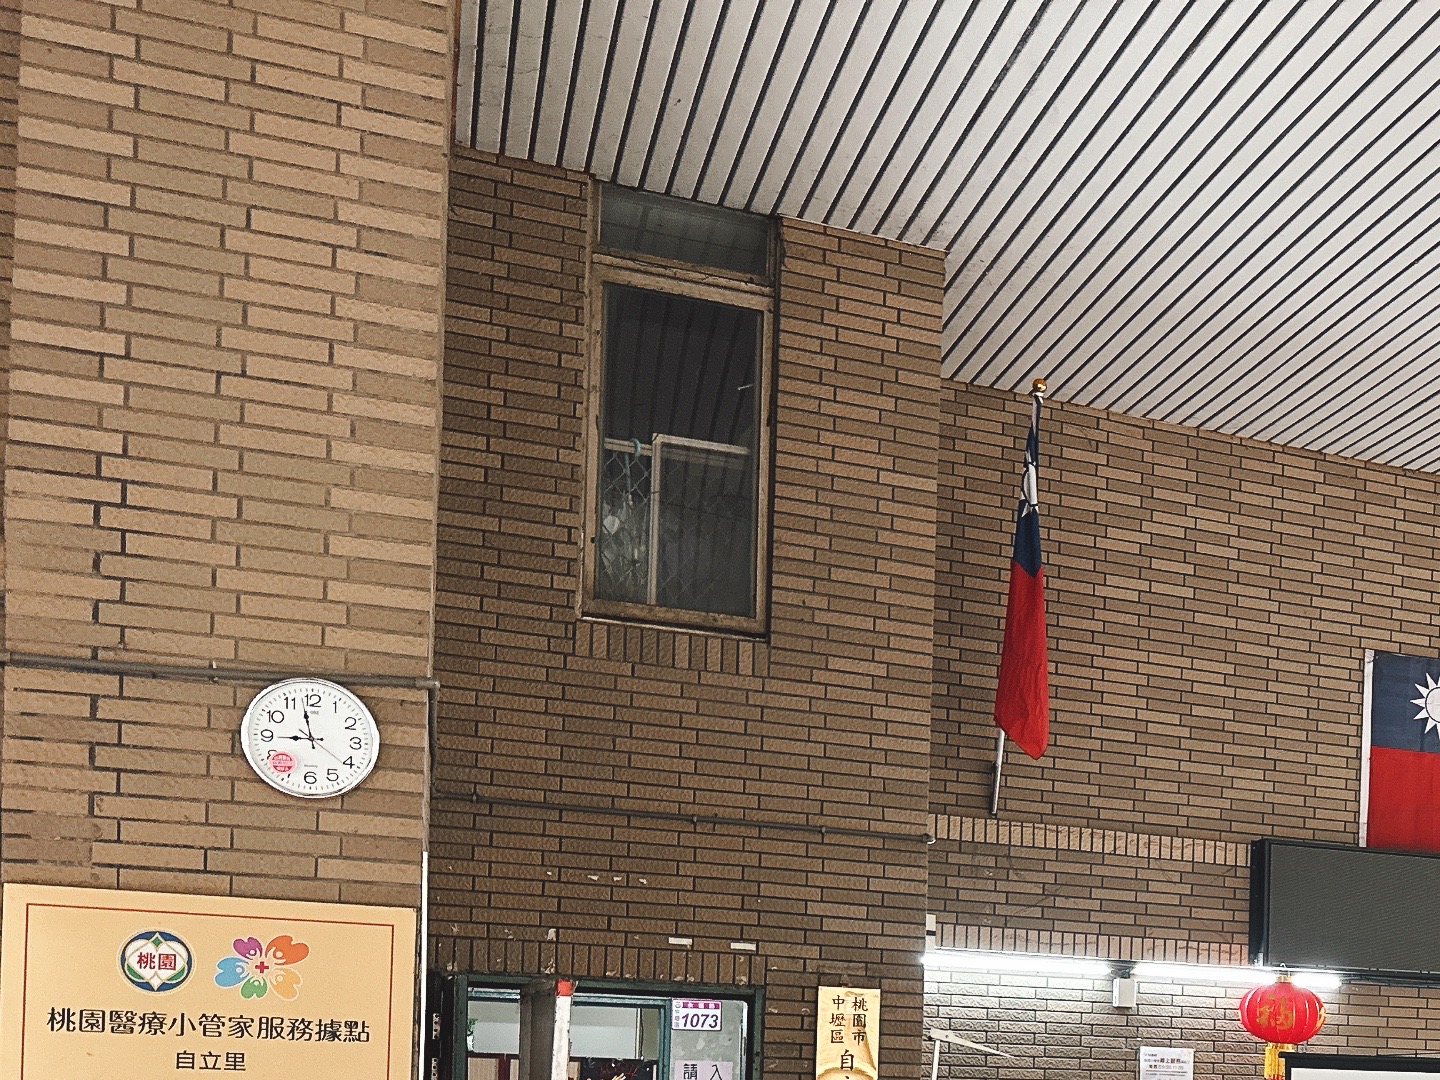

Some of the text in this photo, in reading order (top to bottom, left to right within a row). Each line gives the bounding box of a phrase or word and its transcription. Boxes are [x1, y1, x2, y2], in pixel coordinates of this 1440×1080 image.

[284, 697, 296, 710] 11
[304, 694, 321, 707] 12
[267, 710, 284, 723] 10
[344, 717, 356, 730] 2
[261, 729, 273, 742] 9
[349, 737, 362, 750] 3
[342, 756, 355, 769] 4
[304, 771, 317, 784] 6
[326, 769, 339, 782] 5
[137, 952, 176, 970] 桃園
[46, 1006, 370, 1043] 桃園醫療小管家服務據點
[681, 1013, 719, 1029] 1073
[829, 994, 847, 1044] 中壢區
[851, 996, 869, 1046] 桃園市
[175, 1050, 246, 1072] 自立里
